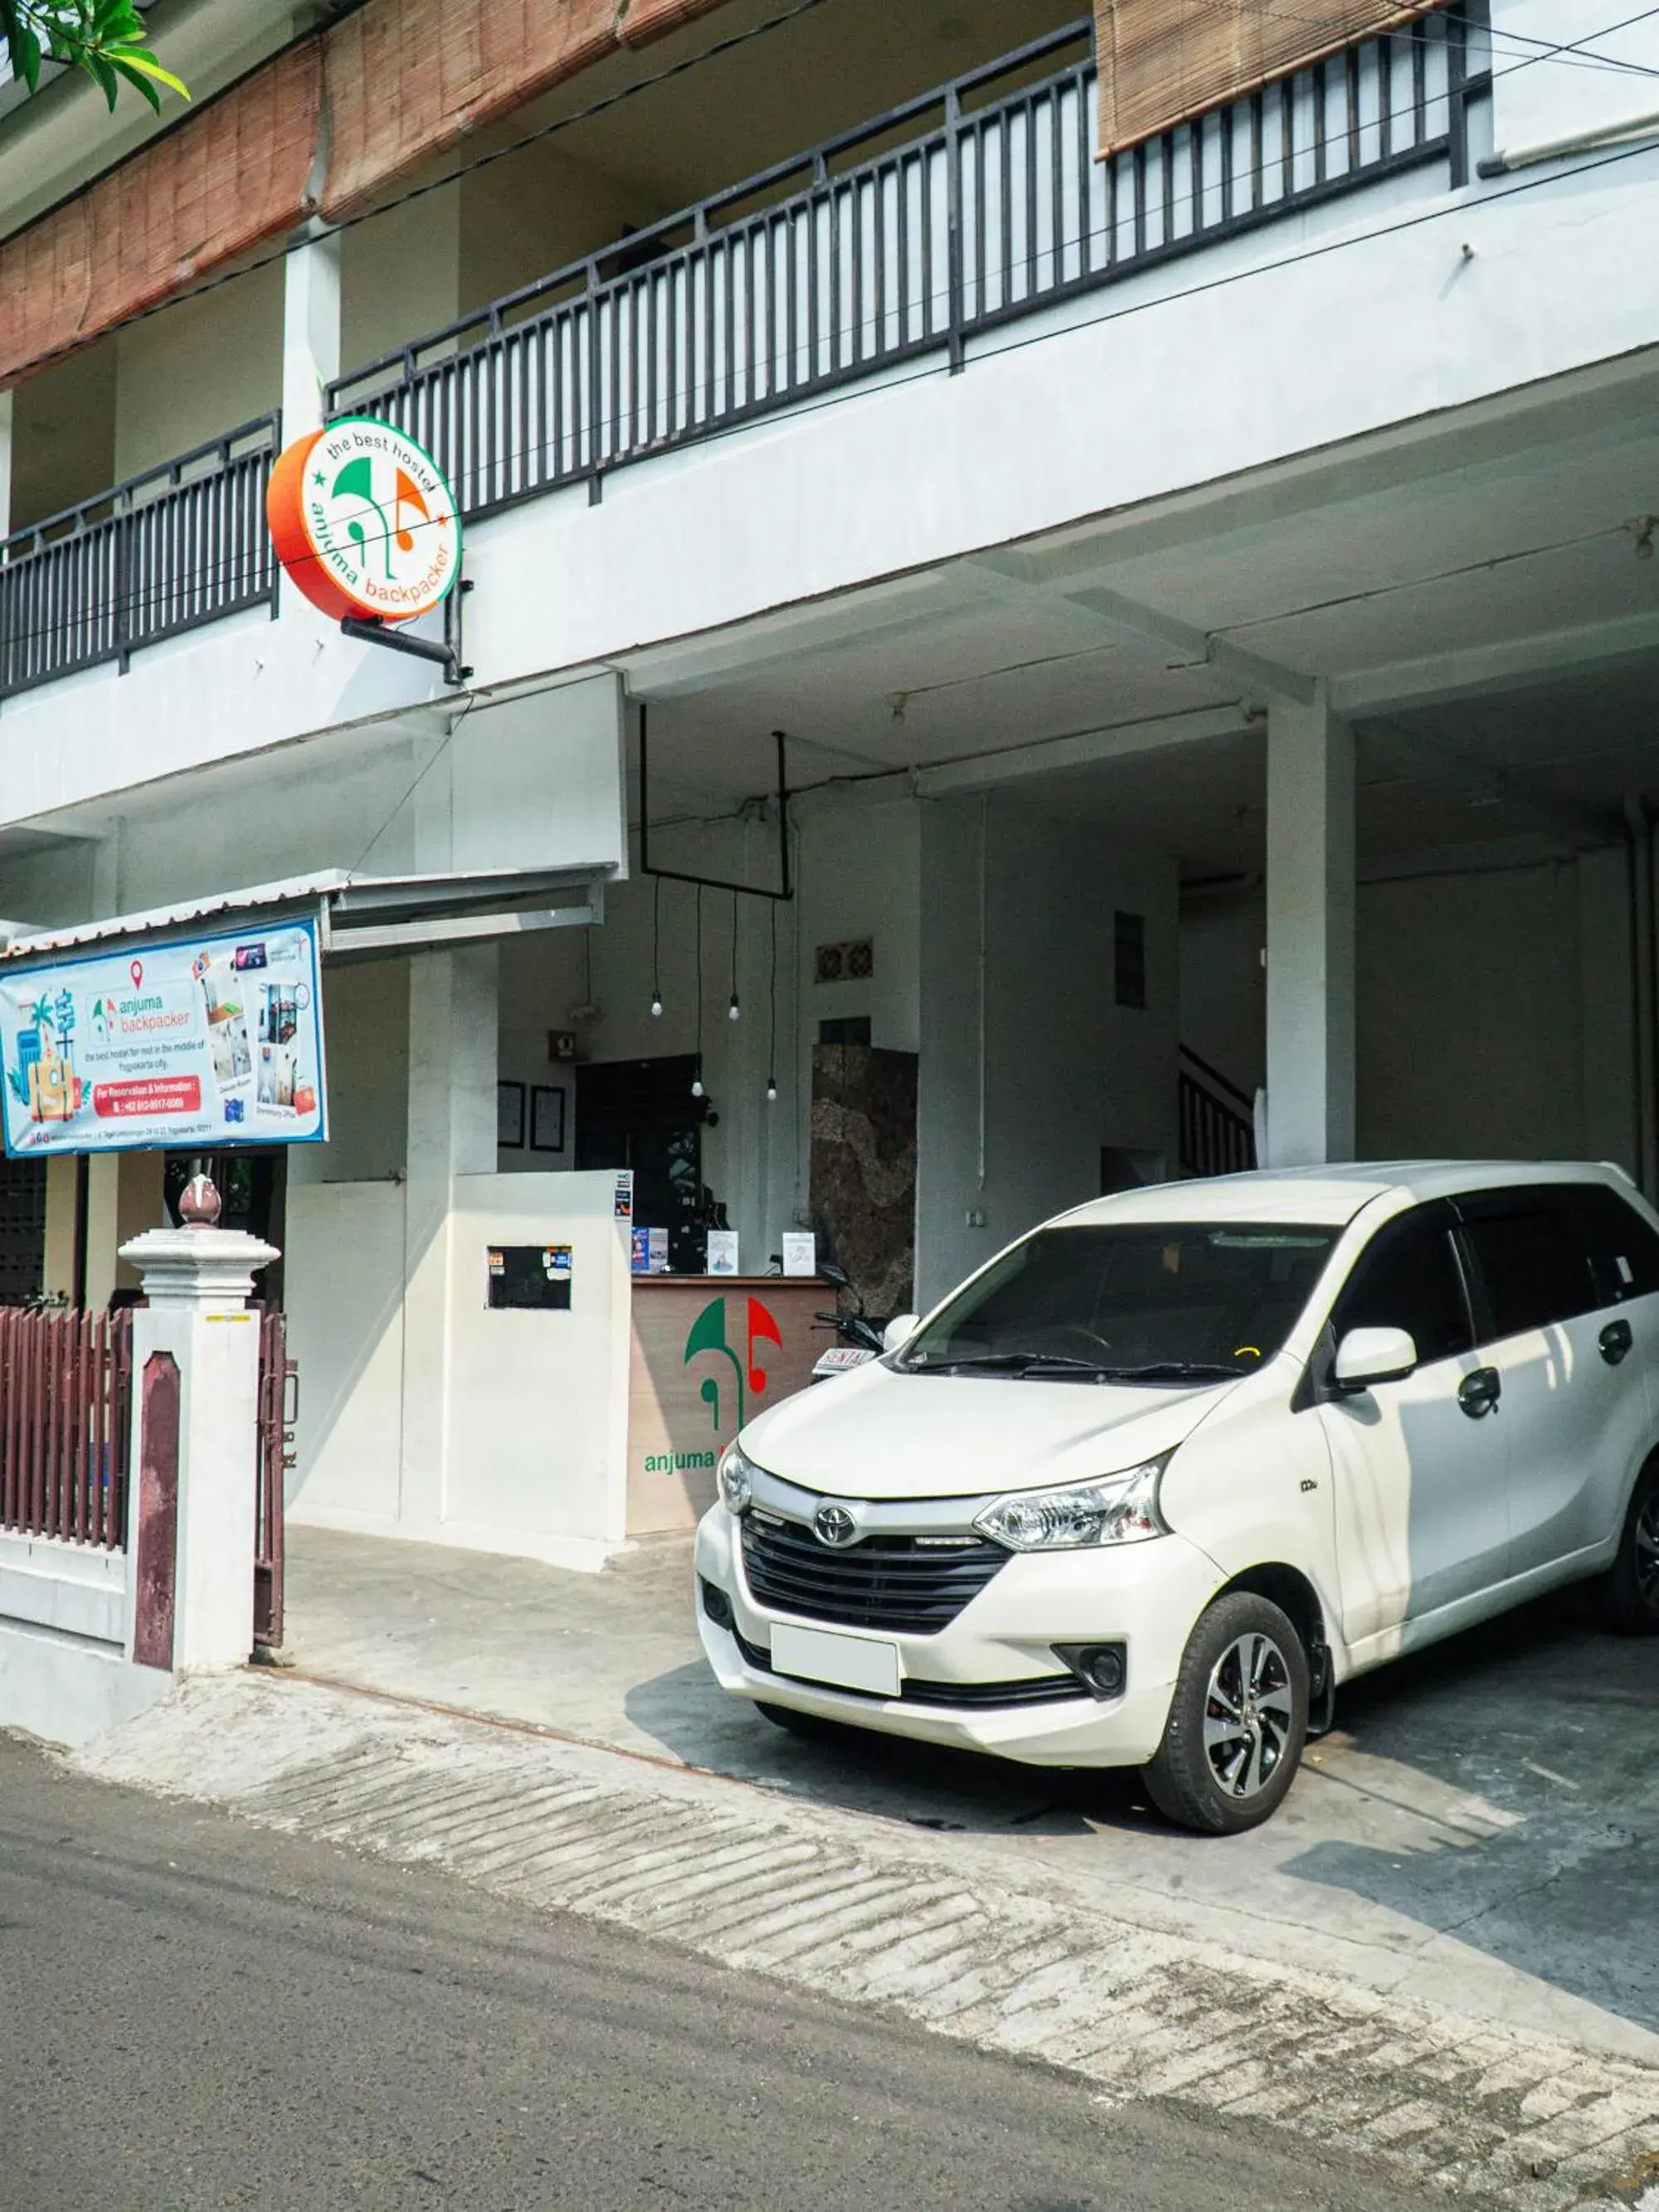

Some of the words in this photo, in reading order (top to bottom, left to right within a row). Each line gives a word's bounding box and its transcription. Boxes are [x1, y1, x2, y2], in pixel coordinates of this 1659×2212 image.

[327, 435, 352, 459] the
[353, 431, 388, 451] best
[392, 441, 439, 493] hostel
[312, 502, 358, 585] anjuma
[365, 543, 450, 604] backpacker
[119, 996, 163, 1015] anjuma
[122, 1012, 190, 1033] backpacker
[645, 1451, 714, 1475] anjuma
